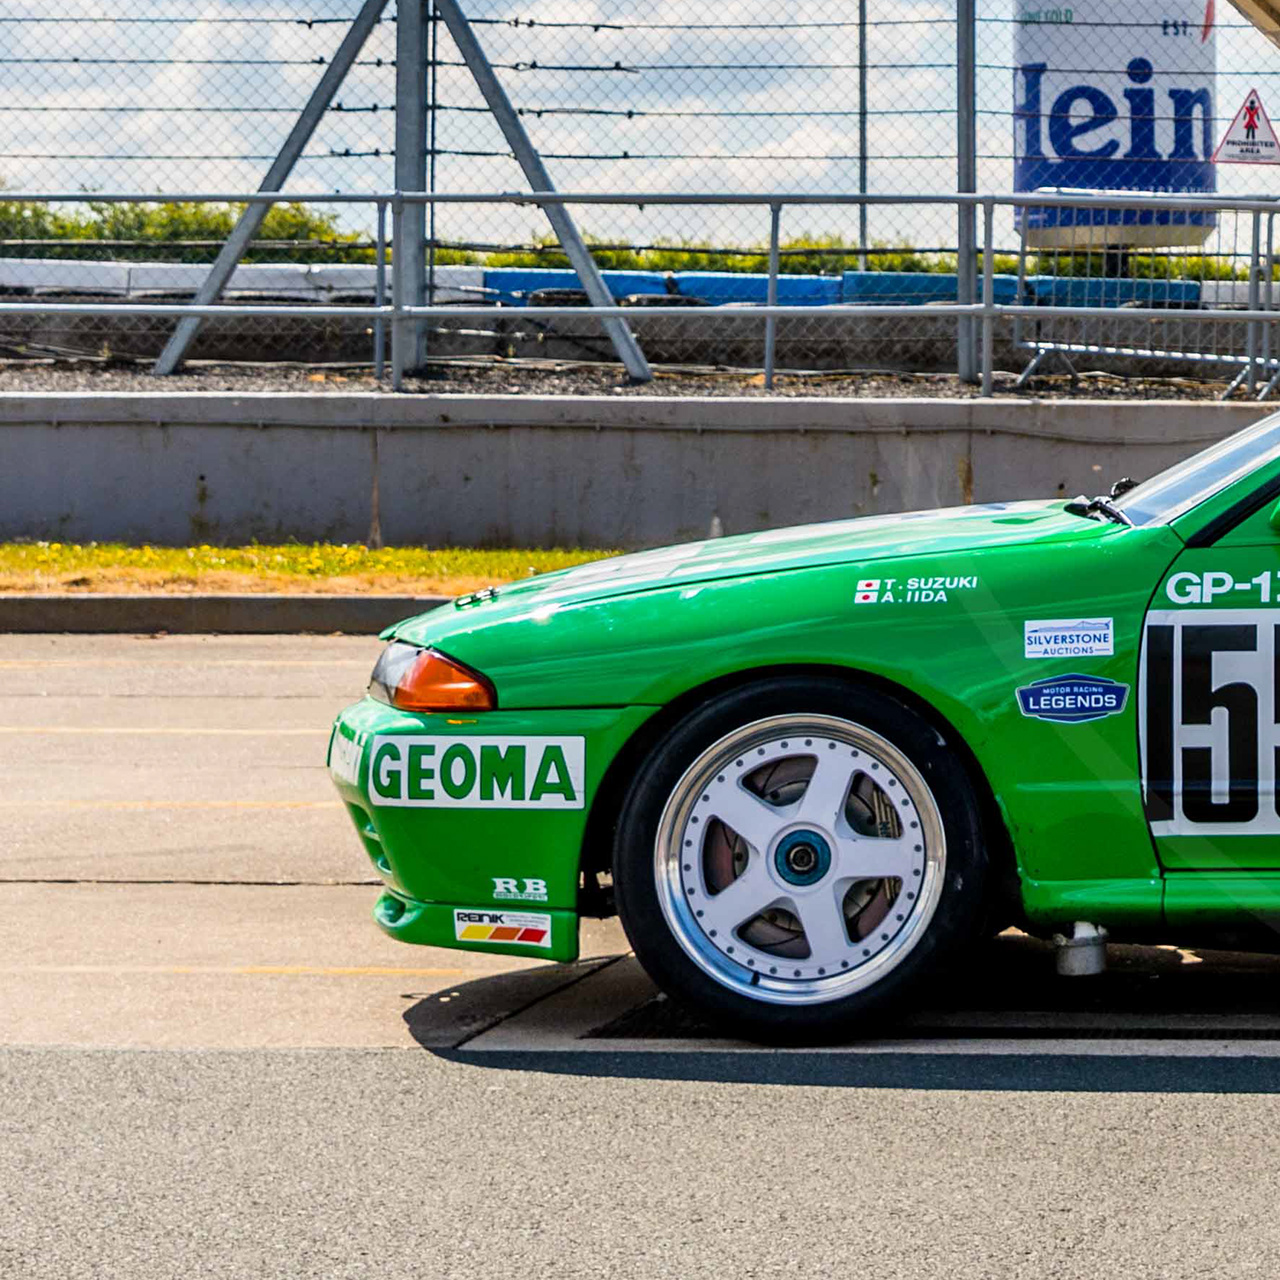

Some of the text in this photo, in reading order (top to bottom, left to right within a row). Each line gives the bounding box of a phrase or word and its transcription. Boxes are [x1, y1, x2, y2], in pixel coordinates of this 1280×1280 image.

[1225, 139, 1276, 148] PROHIBITED
[906, 576, 978, 590] SUZUKI
[1026, 632, 1110, 646] SILVERSTONE
[1042, 646, 1095, 656] AUCTIONS
[1043, 686, 1104, 694] MOTOR RACING
[1029, 693, 1117, 710] LEGENDS
[371, 742, 578, 801] GEOMA
